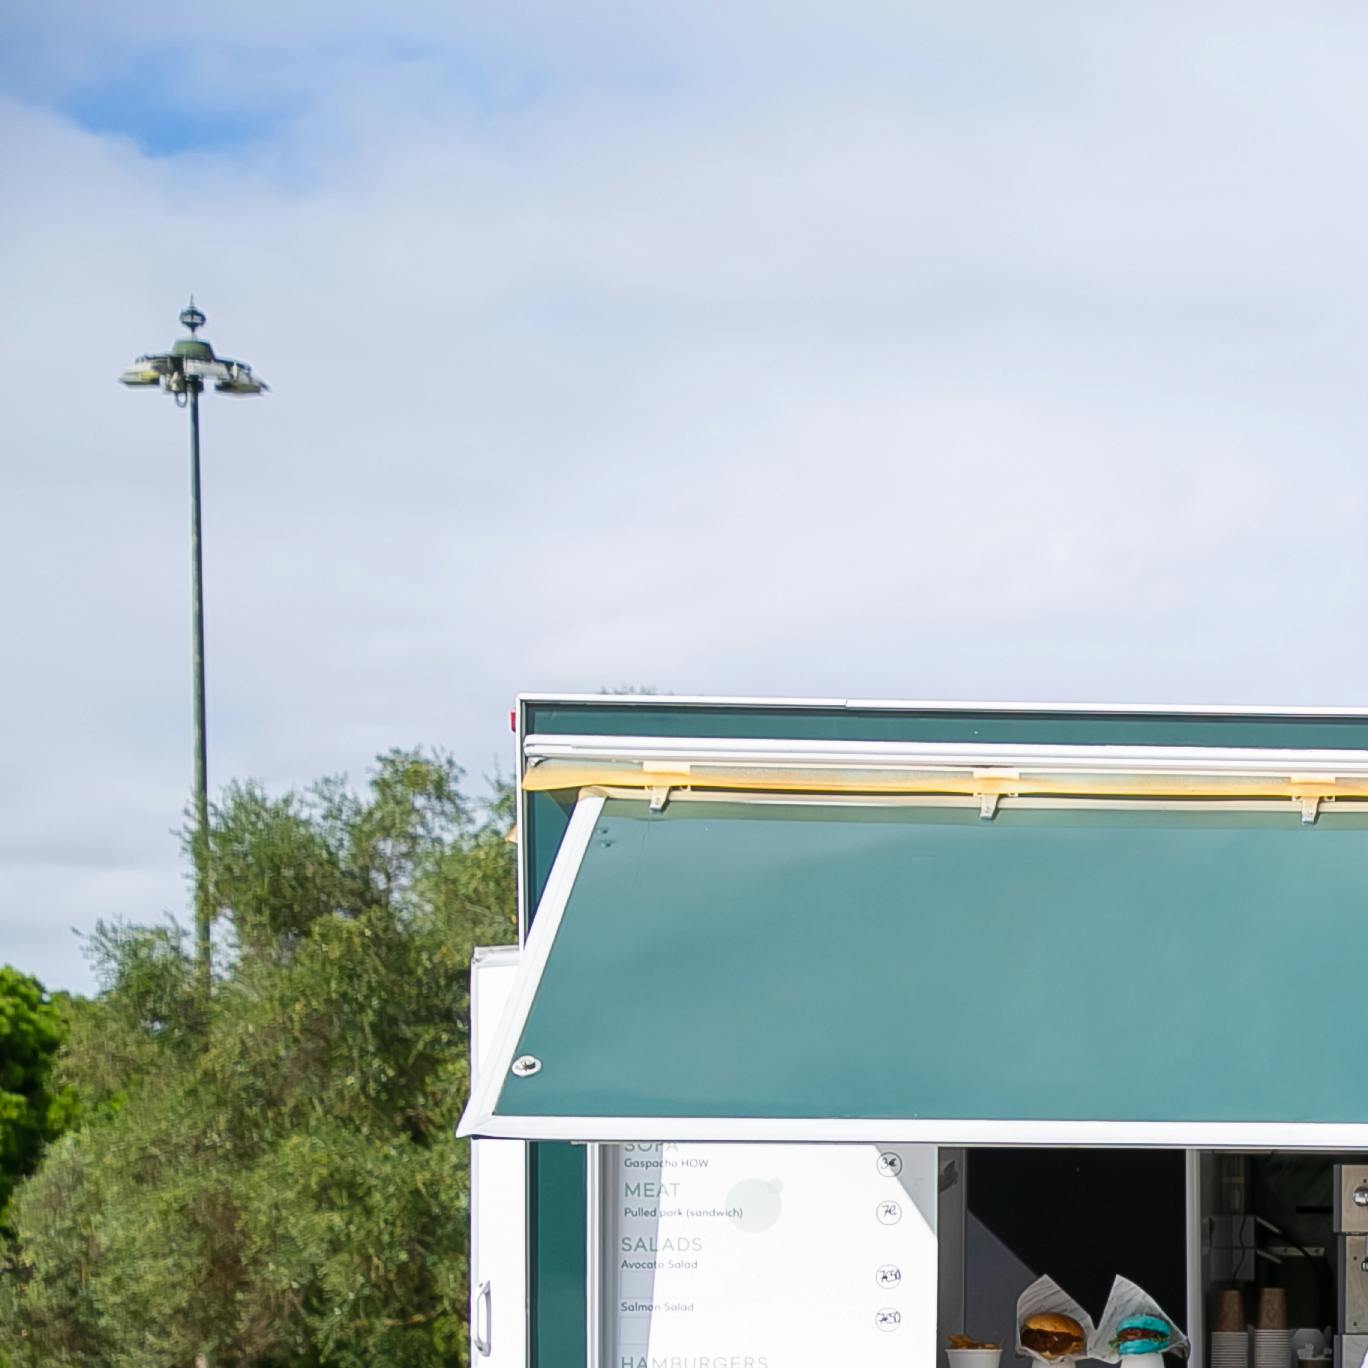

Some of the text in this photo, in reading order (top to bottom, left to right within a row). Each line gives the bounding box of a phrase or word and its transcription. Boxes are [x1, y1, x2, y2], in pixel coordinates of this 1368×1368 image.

[624, 1158, 709, 1170] Gaspacho HOW
[624, 1182, 681, 1198] MEAT
[624, 1207, 744, 1220] Pulled pork (sandwich)
[621, 1236, 703, 1252] SALADS
[621, 1260, 698, 1269] Avocato Salad
[621, 1302, 694, 1311] Salmon Salad
